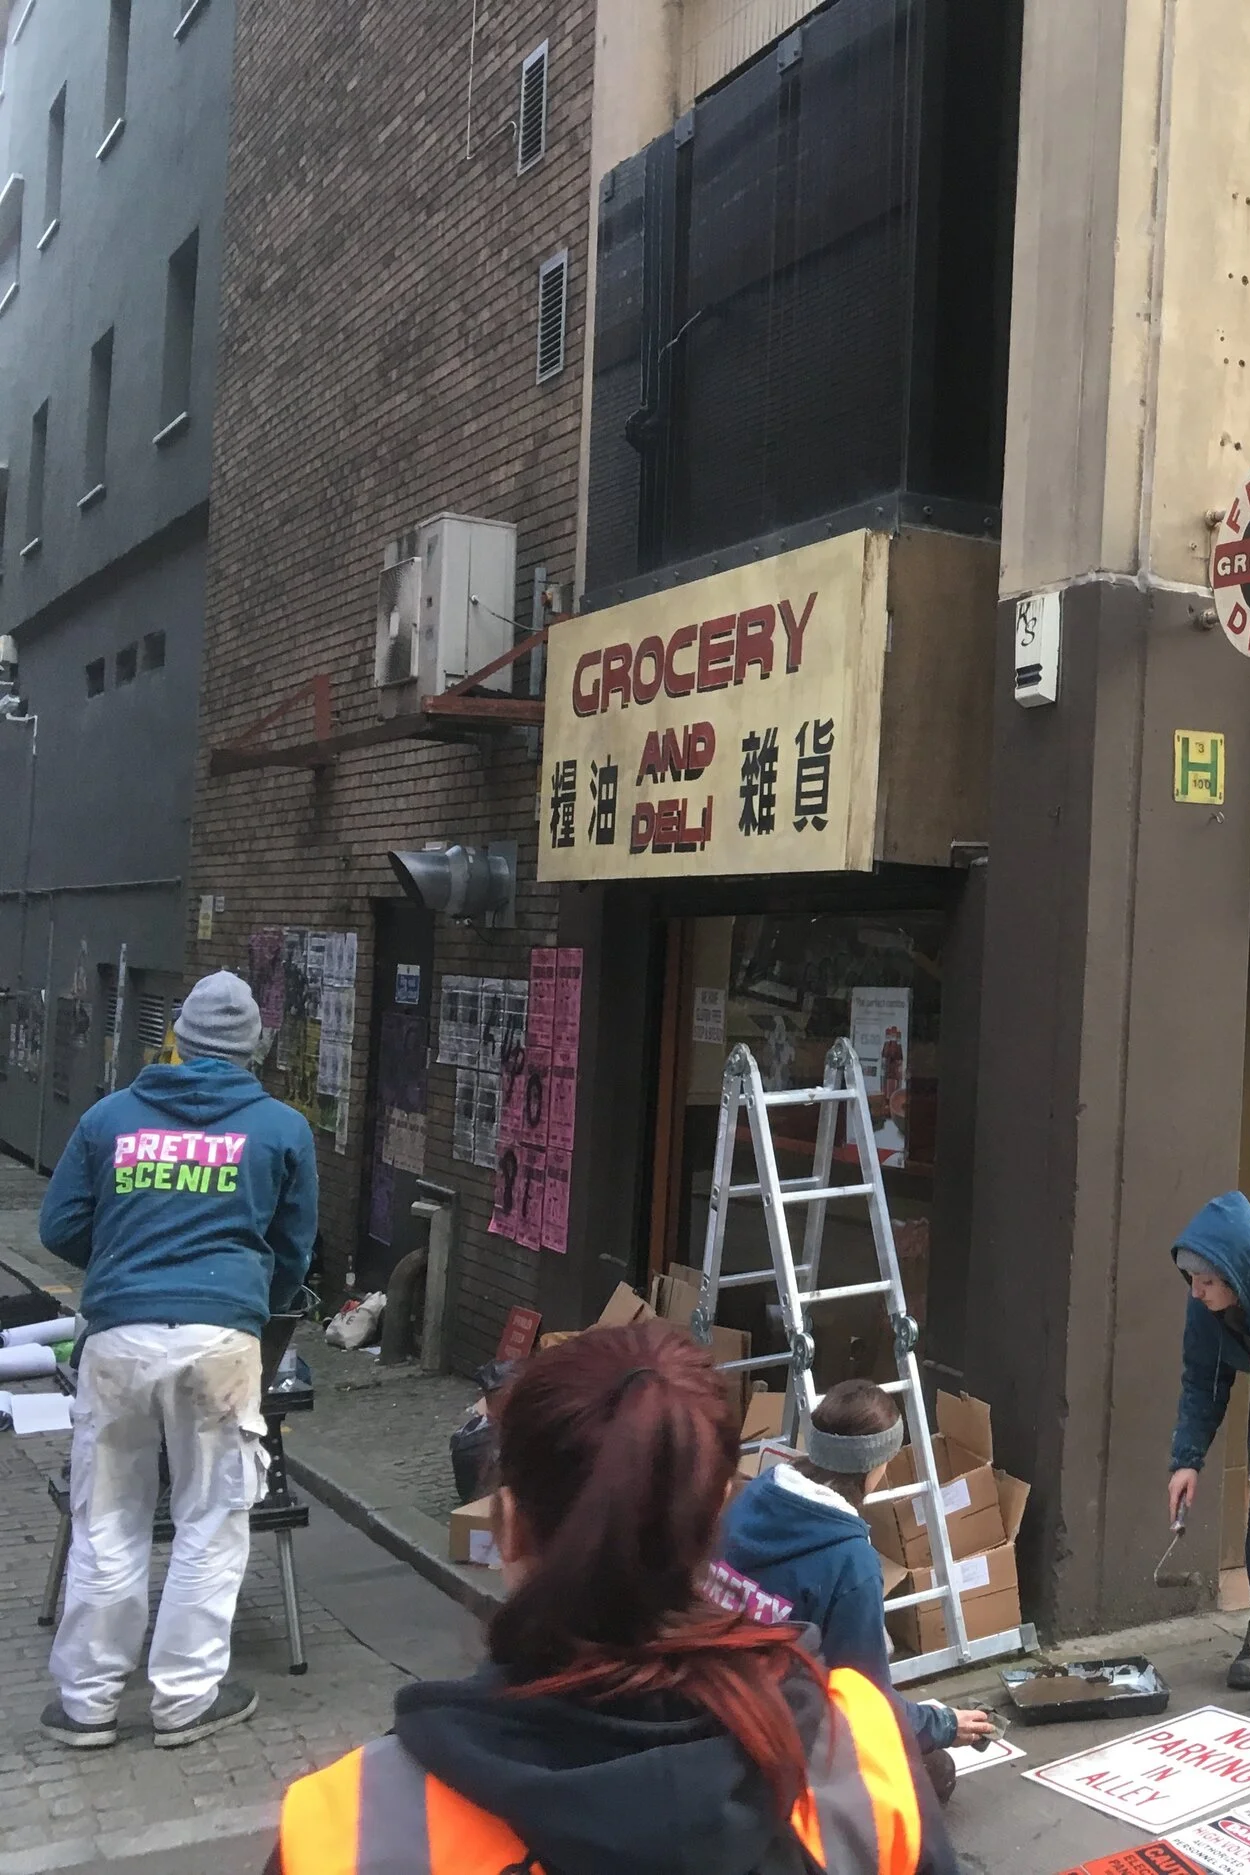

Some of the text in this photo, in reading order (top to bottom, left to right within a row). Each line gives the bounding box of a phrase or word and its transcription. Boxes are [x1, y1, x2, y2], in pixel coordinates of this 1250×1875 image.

[572, 592, 818, 718] GROCERY
[636, 721, 716, 787] AND
[629, 795, 714, 854] DELI
[115, 1133, 247, 1164] PRETTY
[115, 1162, 239, 1194] SCENIC
[1075, 1771, 1170, 1806] ALLEY
[1140, 1764, 1181, 1782] IN
[1194, 1827, 1223, 1844] HIGH
[1145, 1847, 1186, 1875] CAUT
[1172, 1838, 1217, 1866] PERSONNEL
[1192, 1839, 1245, 1868] AUTHORIZED
